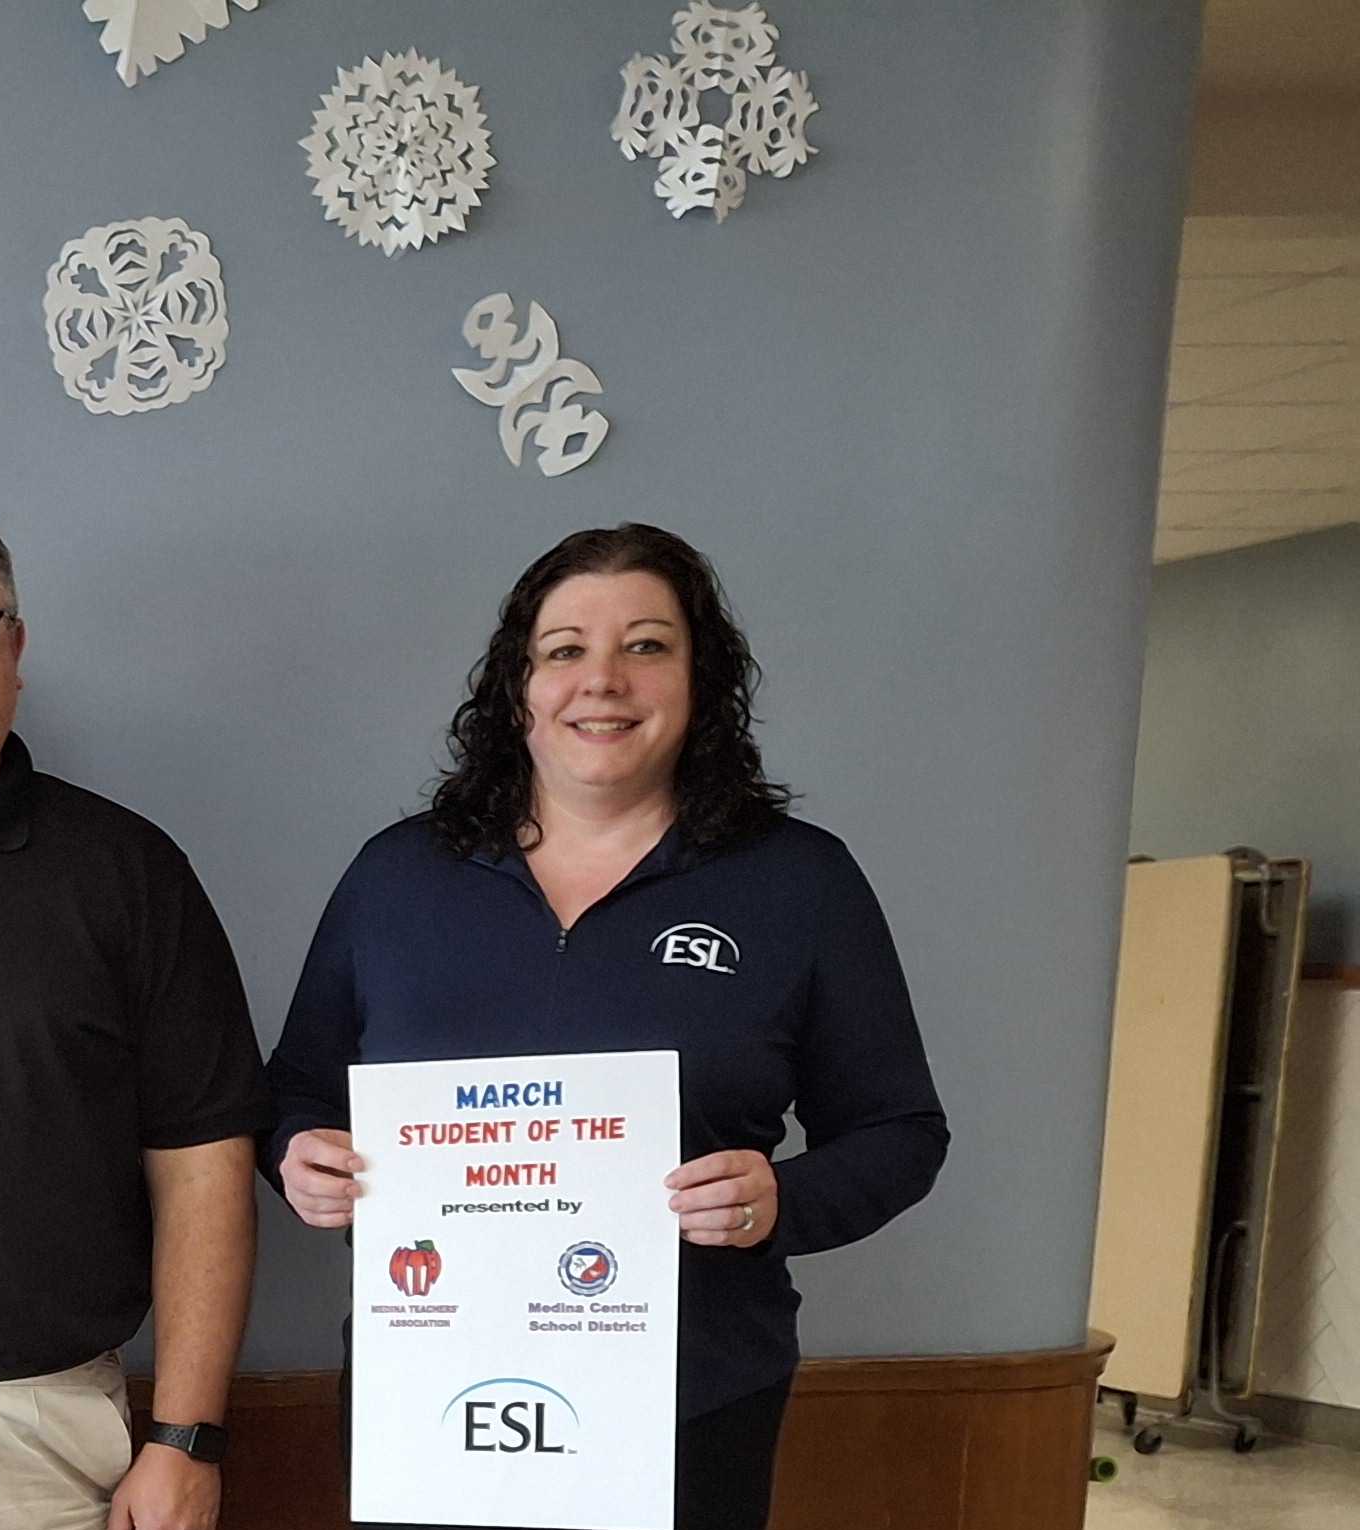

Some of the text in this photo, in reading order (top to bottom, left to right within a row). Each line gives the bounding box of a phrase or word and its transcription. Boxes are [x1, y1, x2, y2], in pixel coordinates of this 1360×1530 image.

[662, 934, 730, 973] ESL
[456, 1080, 563, 1110] MARCH
[399, 1116, 626, 1146] STUDENT OF THE
[465, 1162, 557, 1187] MONTH
[441, 1198, 584, 1217] presented by
[527, 1302, 649, 1314] Medina Central
[388, 1318, 451, 1328] ASSOCIATION
[528, 1320, 647, 1332] School District
[464, 1400, 564, 1453] ESL
